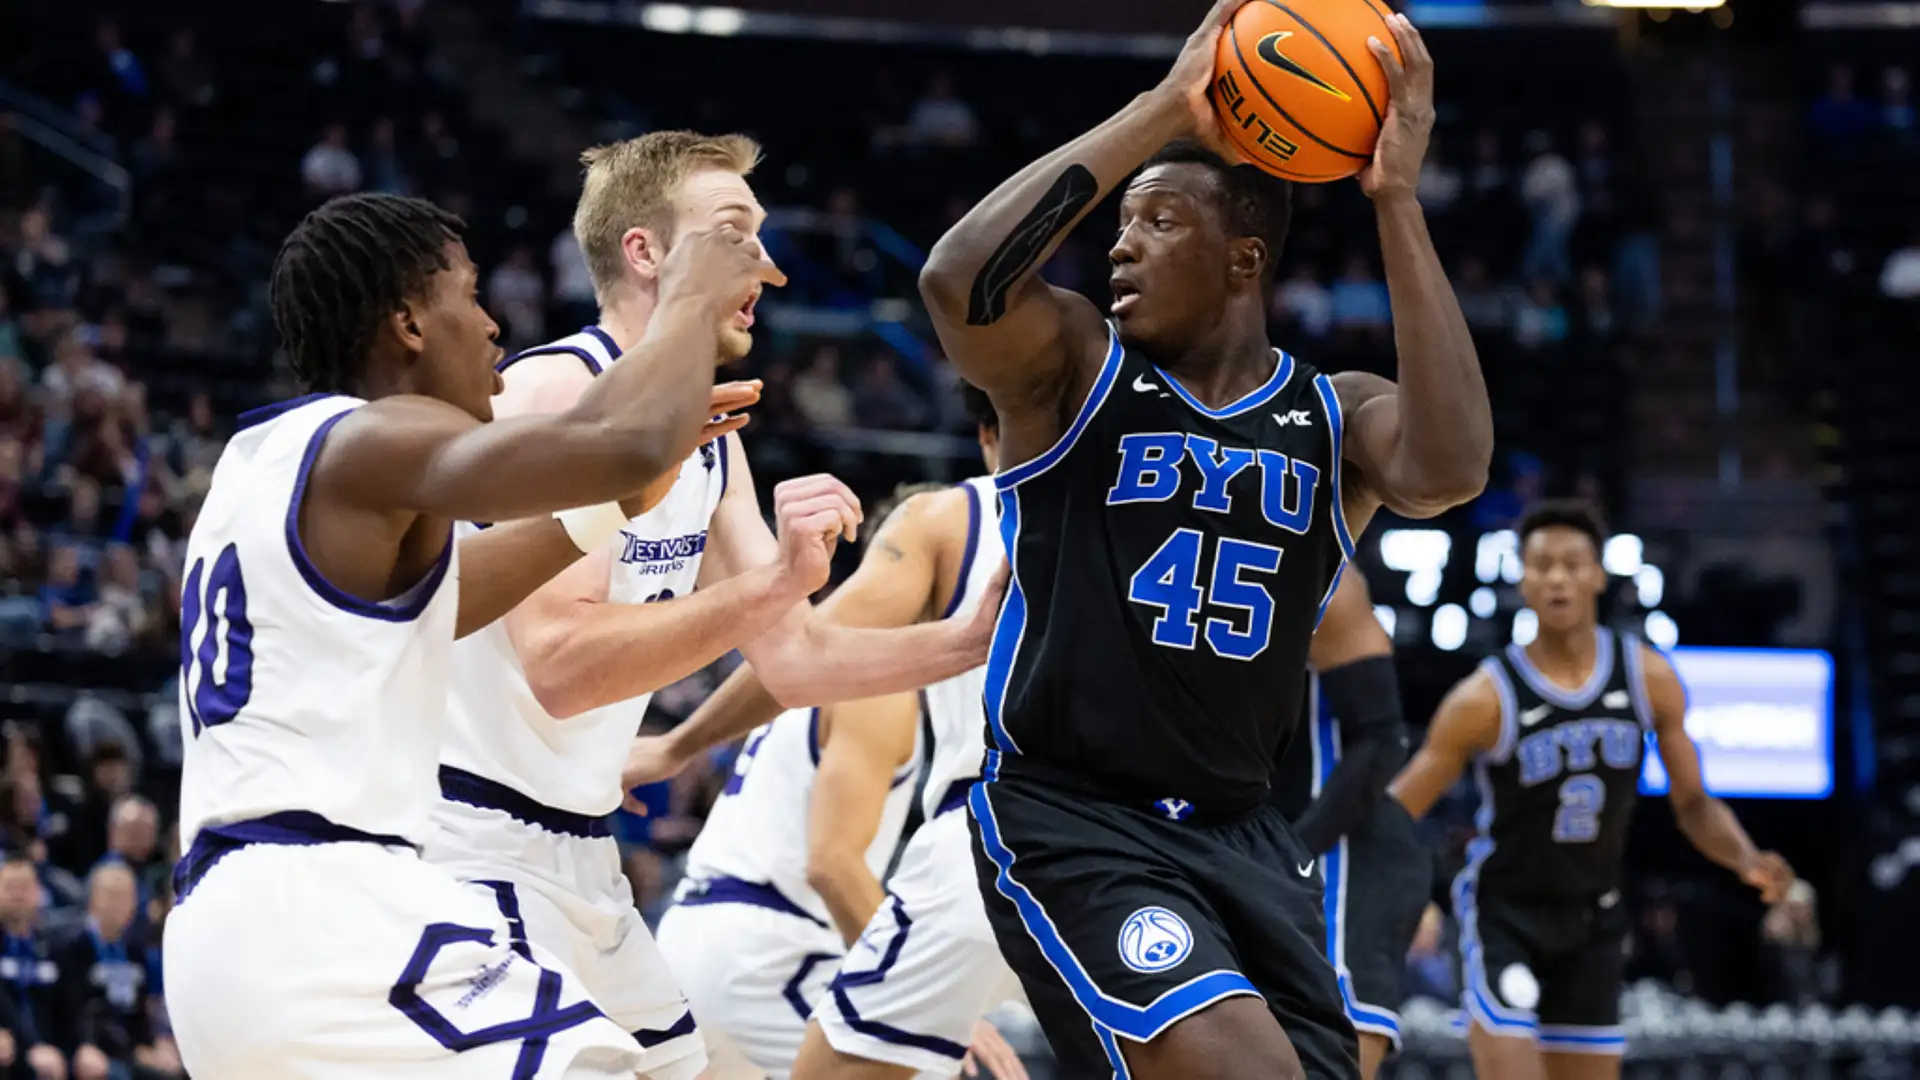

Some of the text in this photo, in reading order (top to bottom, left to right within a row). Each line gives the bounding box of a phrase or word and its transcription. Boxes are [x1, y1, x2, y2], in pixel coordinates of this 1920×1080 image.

[1217, 70, 1300, 162] ELITE
[1106, 432, 1320, 535] BYU
[1128, 527, 1284, 661] 45
[1518, 718, 1641, 788] BYU
[1552, 773, 1607, 843] 2
